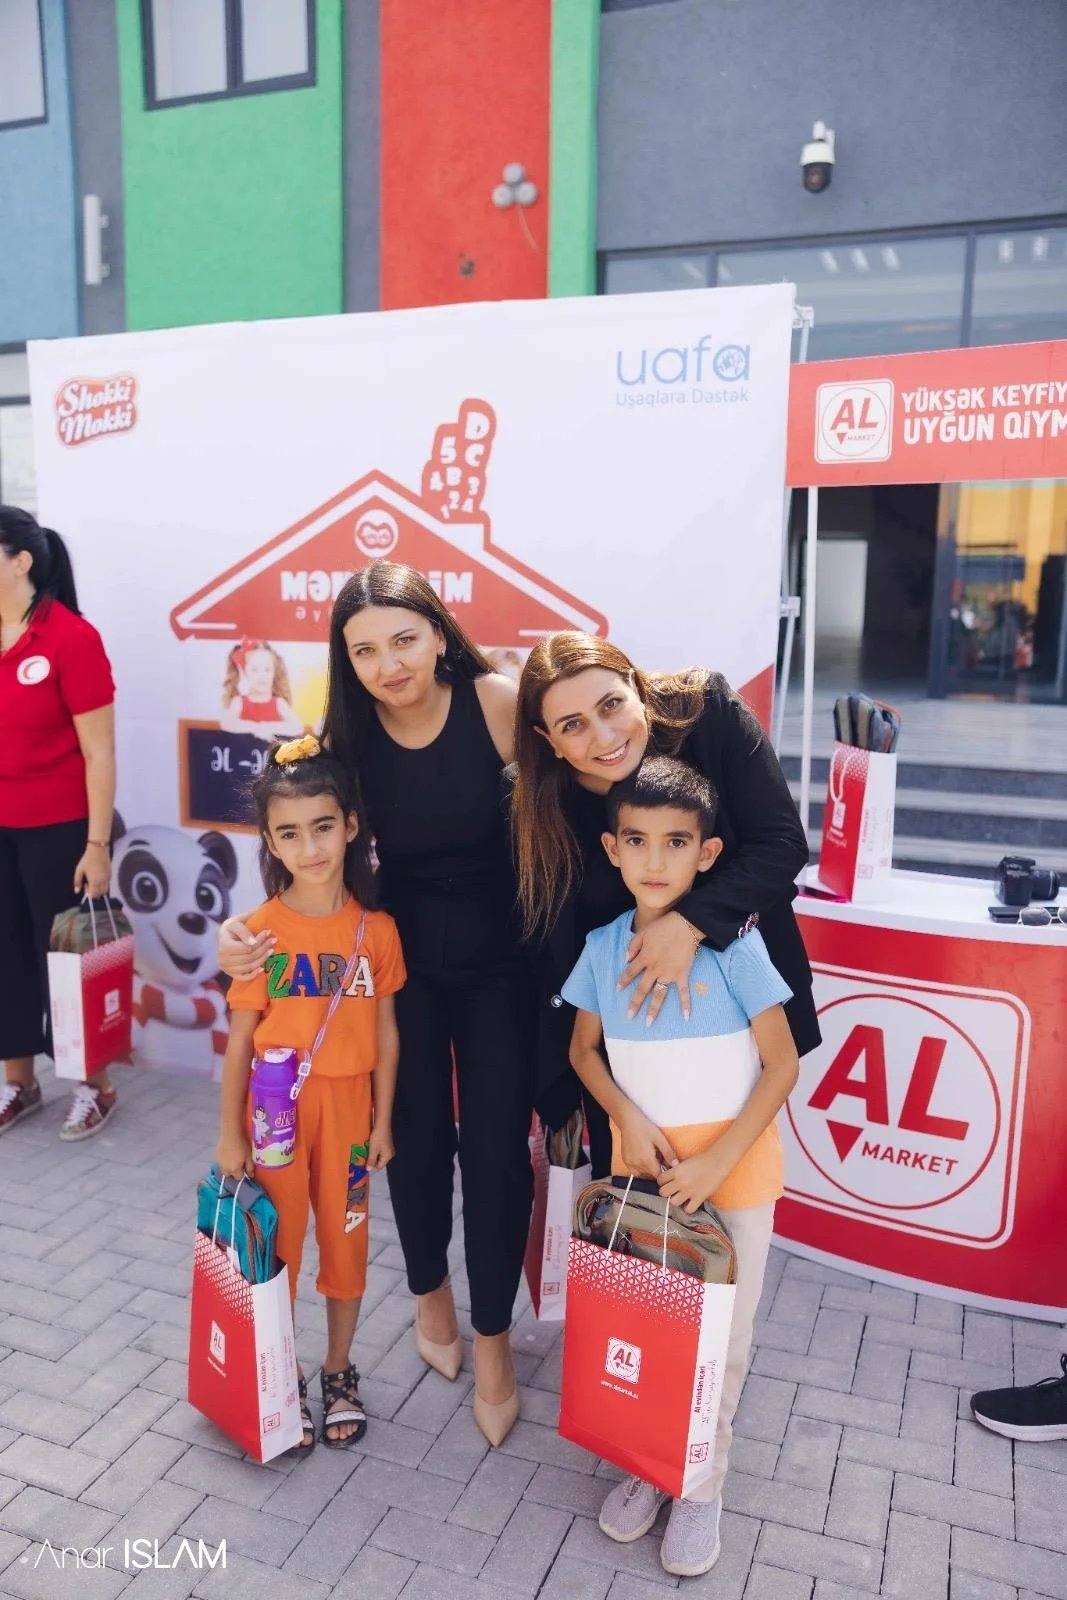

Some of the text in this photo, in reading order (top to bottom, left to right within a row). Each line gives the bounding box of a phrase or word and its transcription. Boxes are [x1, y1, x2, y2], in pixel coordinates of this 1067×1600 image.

[616, 334, 751, 386] uafa
[829, 397, 879, 431] AL
[903, 410, 995, 446] UYĞUN
[264, 953, 375, 998] ZARA
[807, 1024, 970, 1141] AL
[861, 1141, 959, 1175] MARKET
[344, 1139, 369, 1233] ZARA
[613, 1348, 634, 1368] AL
